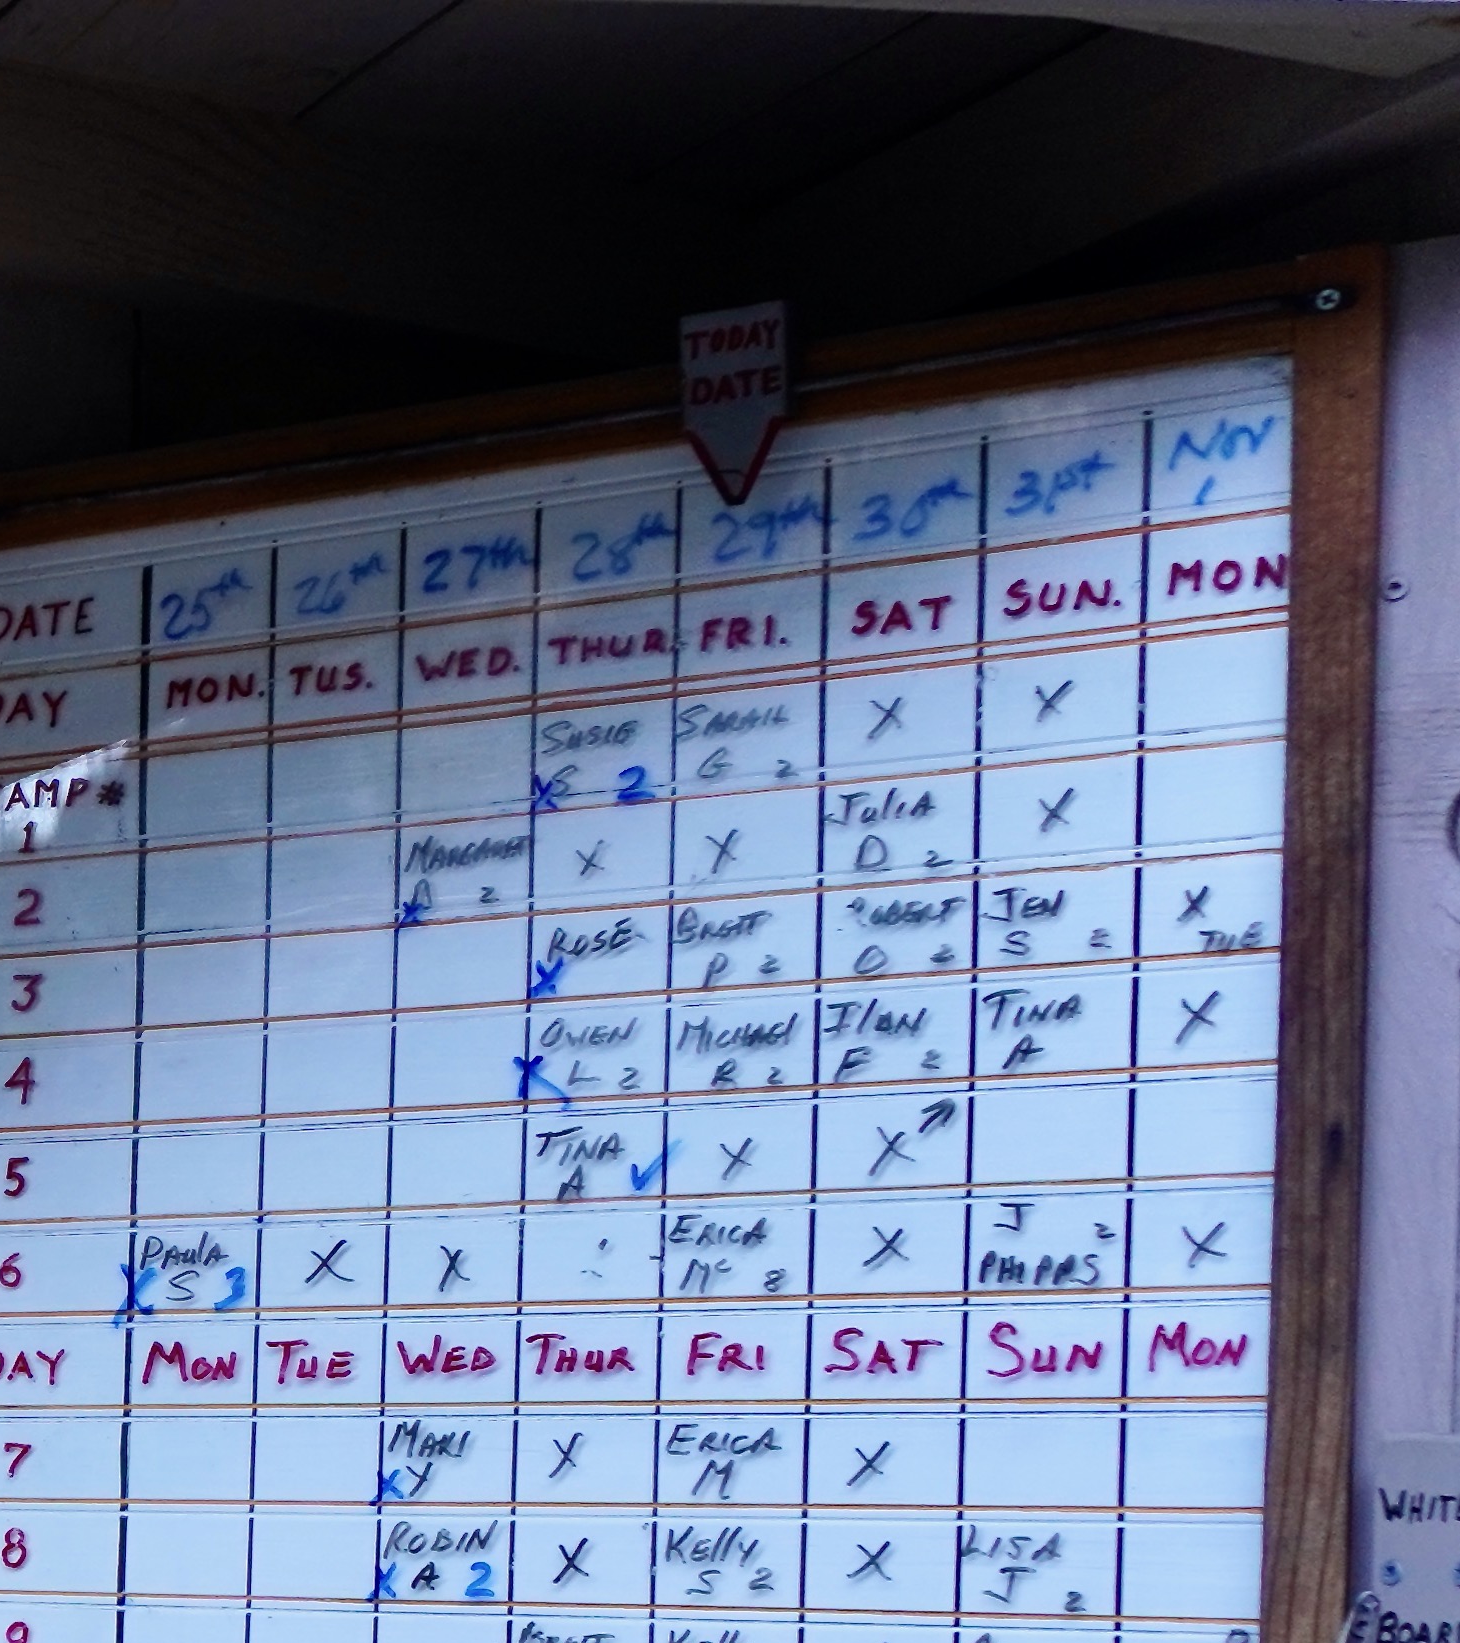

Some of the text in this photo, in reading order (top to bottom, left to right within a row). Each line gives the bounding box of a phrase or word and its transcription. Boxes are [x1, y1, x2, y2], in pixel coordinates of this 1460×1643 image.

[683, 317, 783, 362] TODAY
[689, 365, 784, 406] DATE
[415, 643, 521, 682] WED.
[698, 614, 790, 654] FRI.
[851, 595, 953, 637] SAT
[1001, 577, 1123, 618] SUN.
[1167, 553, 1289, 598] MON
[13, 888, 44, 927] 2
[10, 972, 44, 1013] 3
[3, 1055, 37, 1106] 4
[4, 1155, 32, 1198] 5
[2, 1440, 35, 1480] 7
[1377, 1487, 1460, 1523] WHIT
[0, 1526, 30, 1571] 8
